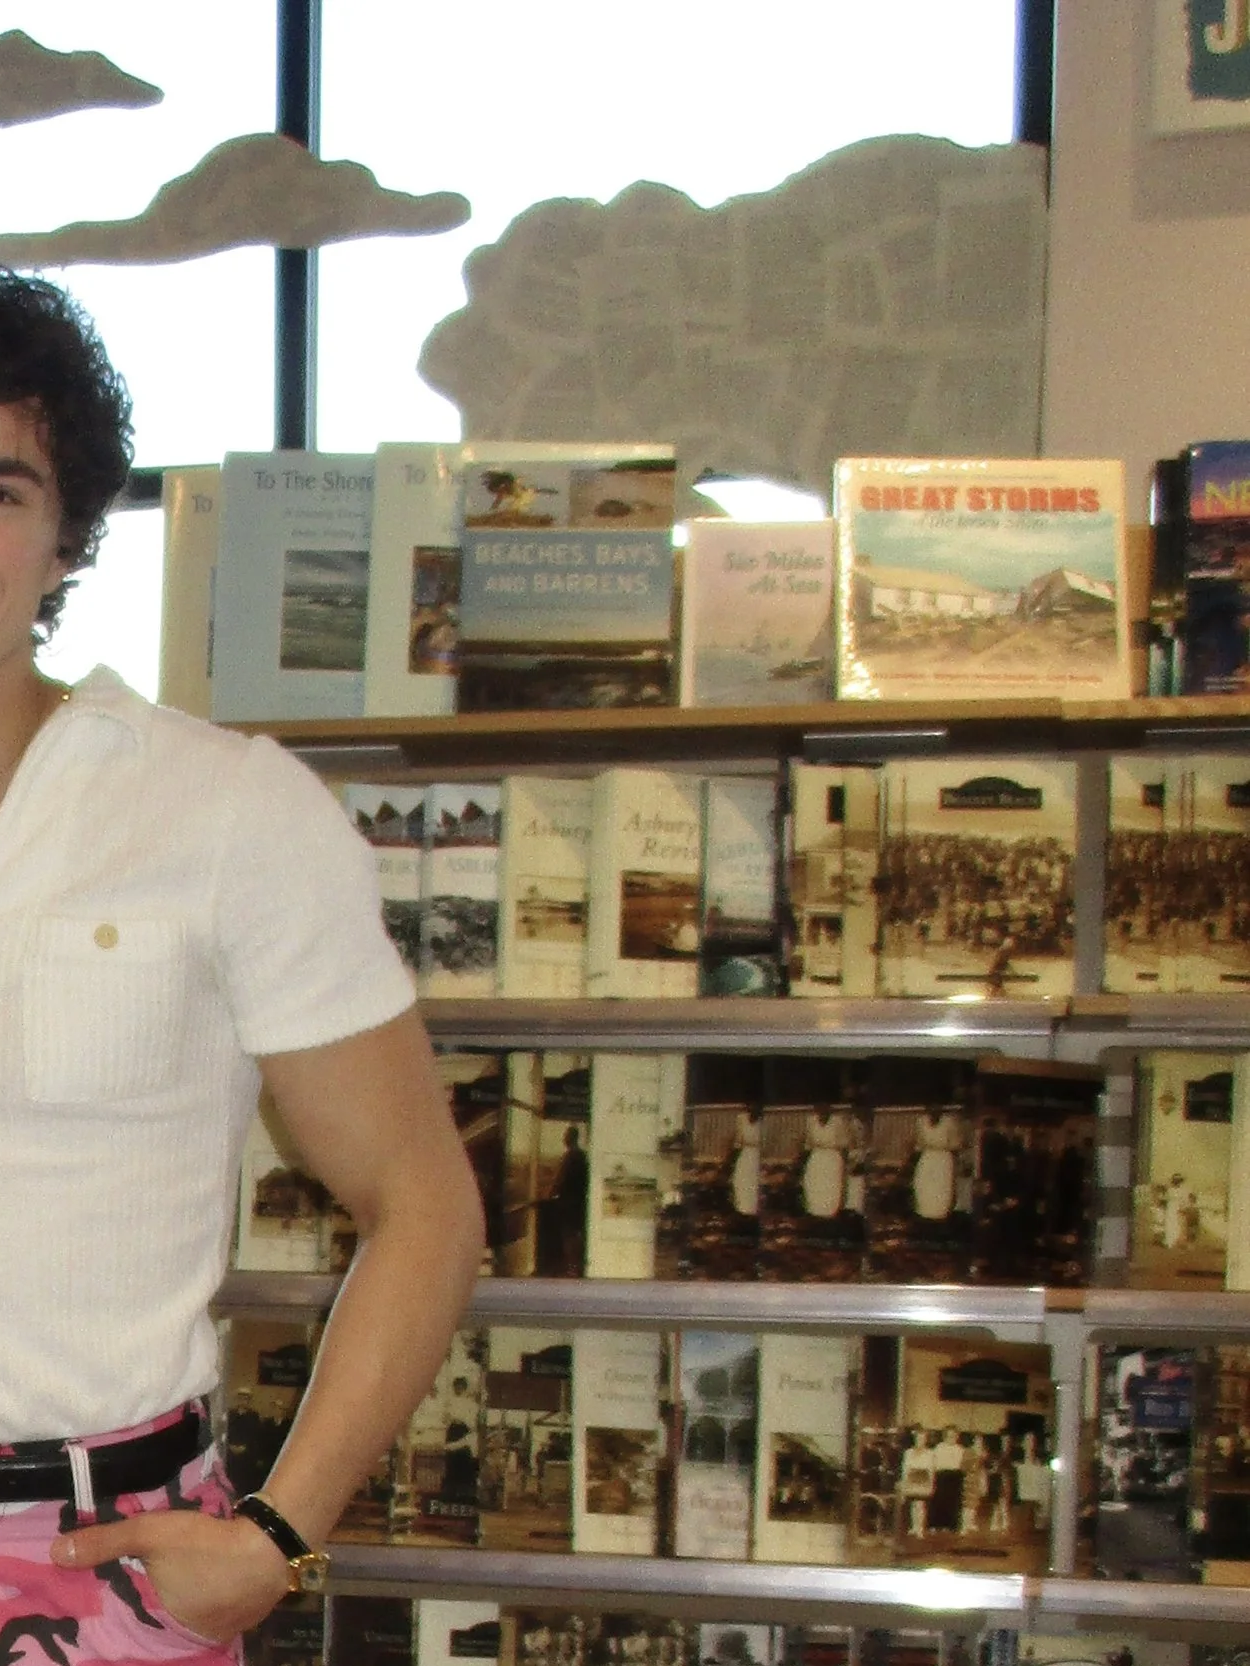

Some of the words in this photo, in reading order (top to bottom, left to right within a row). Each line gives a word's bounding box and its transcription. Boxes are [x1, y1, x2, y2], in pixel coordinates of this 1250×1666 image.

[253, 471, 276, 490] To
[282, 471, 316, 490] The
[860, 486, 958, 512] GREAT
[966, 486, 1100, 513] STORMS
[532, 572, 649, 594] BARRENS
